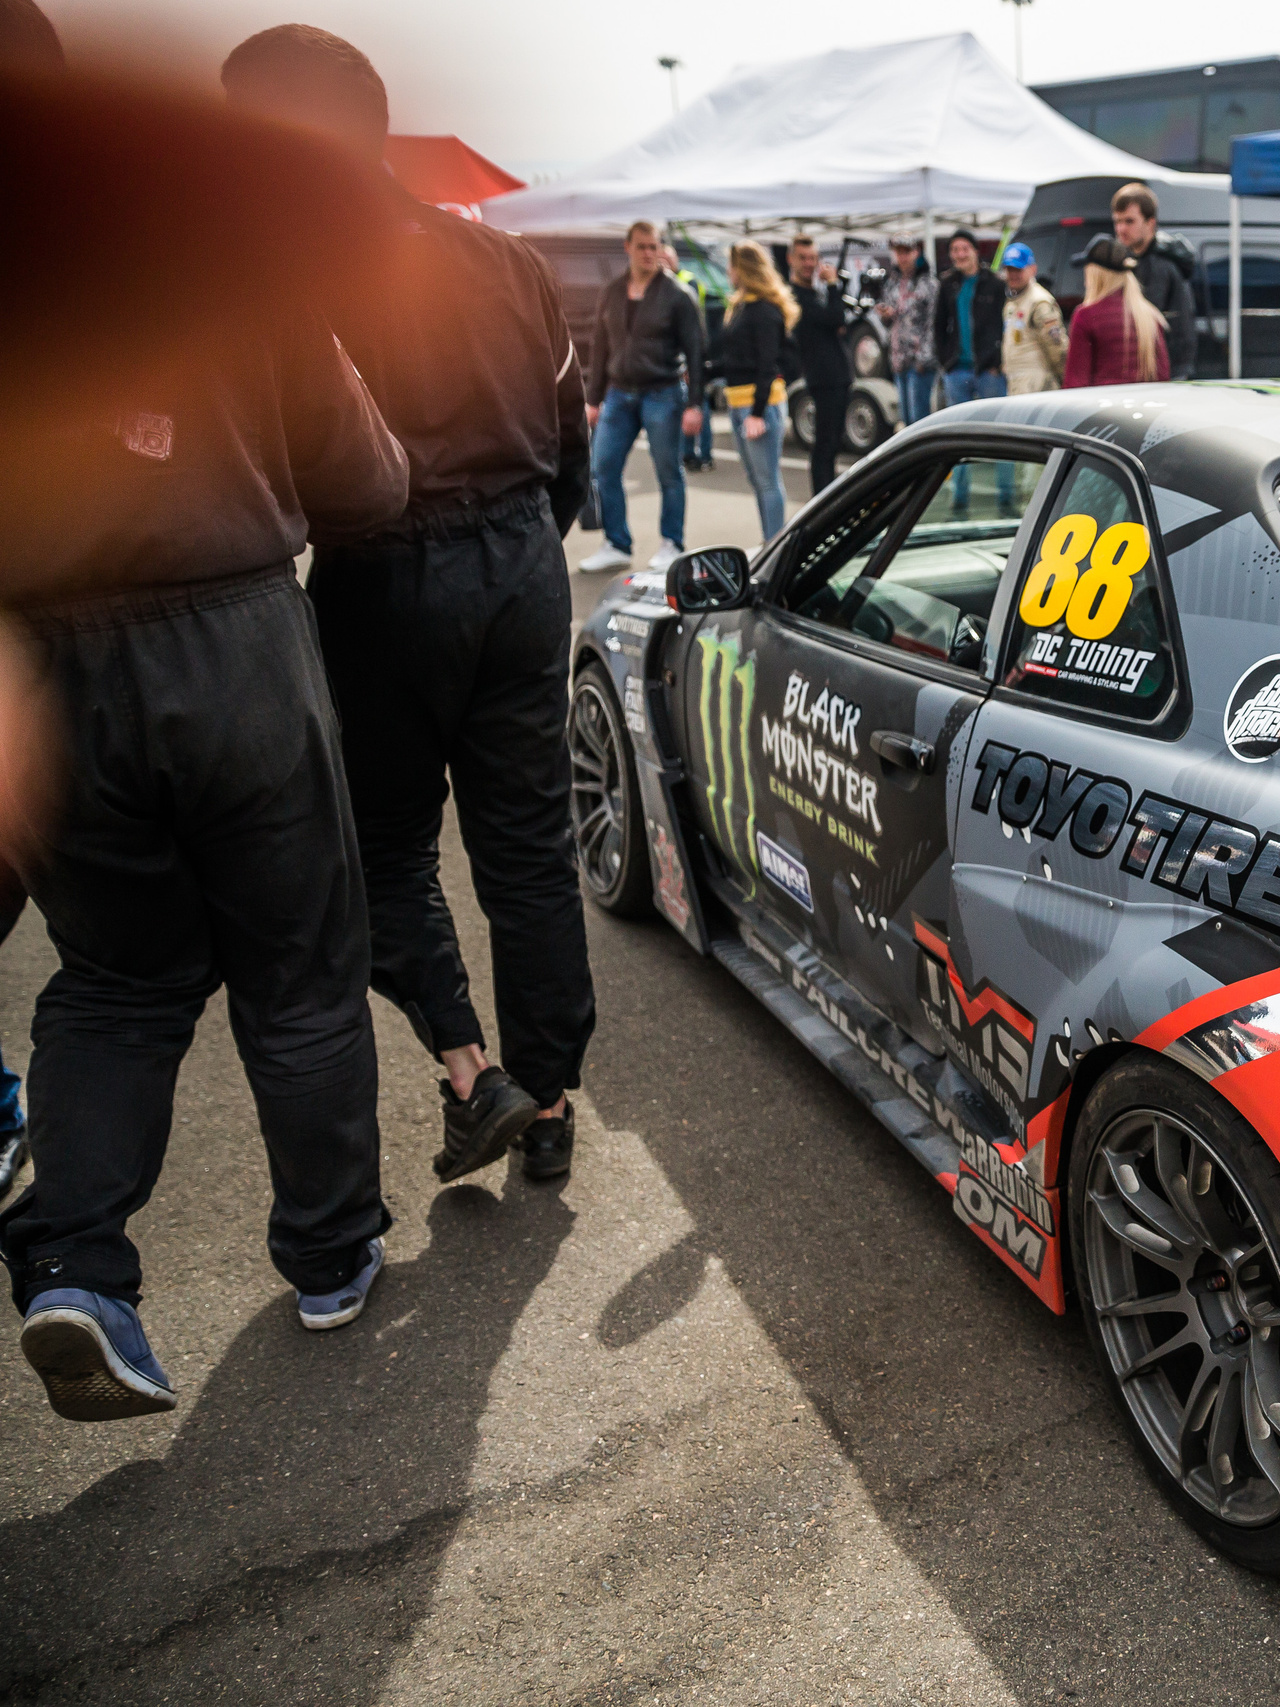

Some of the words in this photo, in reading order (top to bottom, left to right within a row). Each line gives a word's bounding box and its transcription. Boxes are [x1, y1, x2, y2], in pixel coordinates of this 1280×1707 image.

[1019, 513, 1151, 640] 88
[782, 669, 861, 757] BLACK
[769, 774, 824, 825] ENERGY
[827, 811, 880, 868] DRINK
